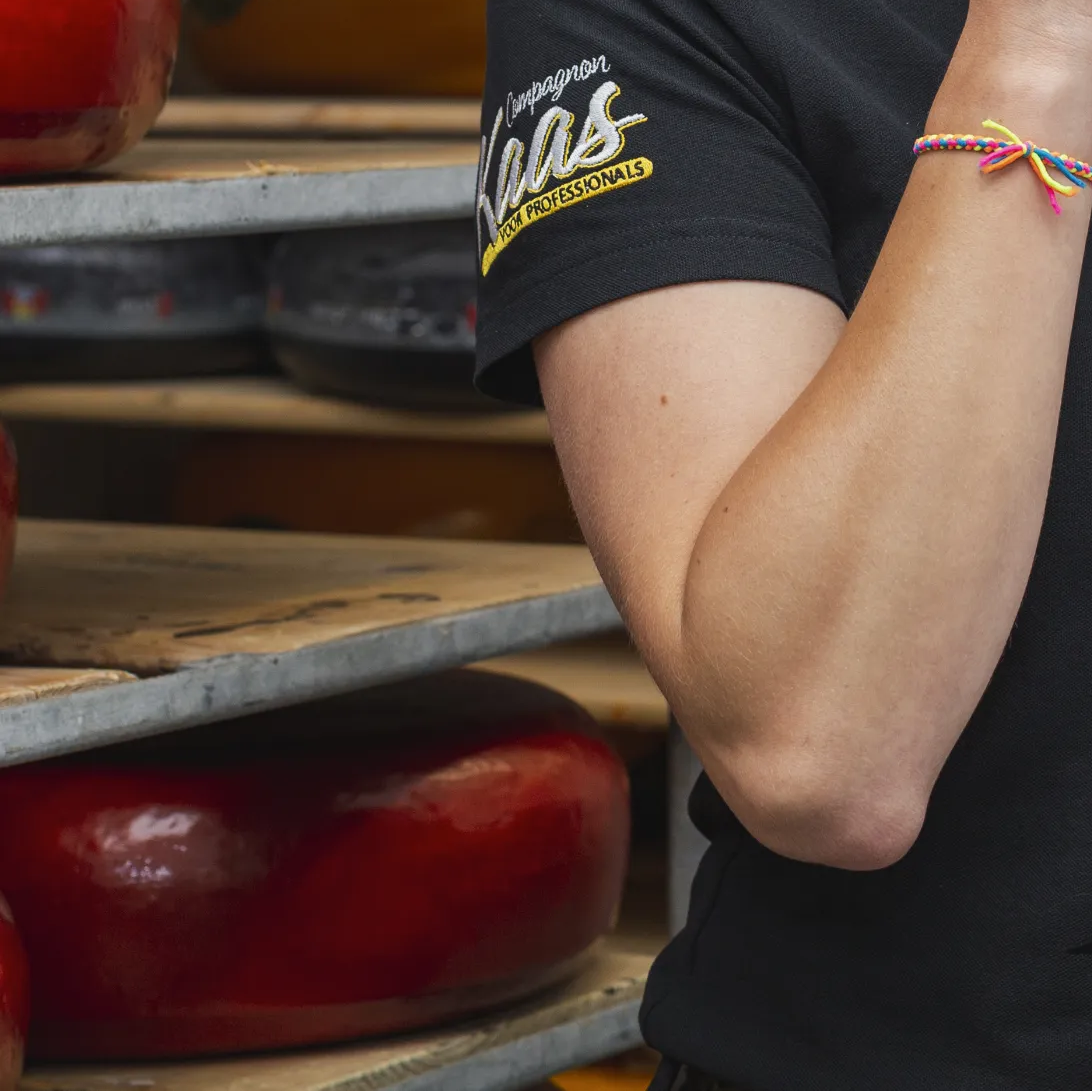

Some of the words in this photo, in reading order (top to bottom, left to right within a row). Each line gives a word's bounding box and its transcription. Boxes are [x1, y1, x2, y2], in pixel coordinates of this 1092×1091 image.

[506, 55, 611, 128] Compagnon
[477, 81, 648, 255] Kaas
[499, 212, 523, 243] VOOR
[526, 160, 646, 220] PROFESSIONALS
